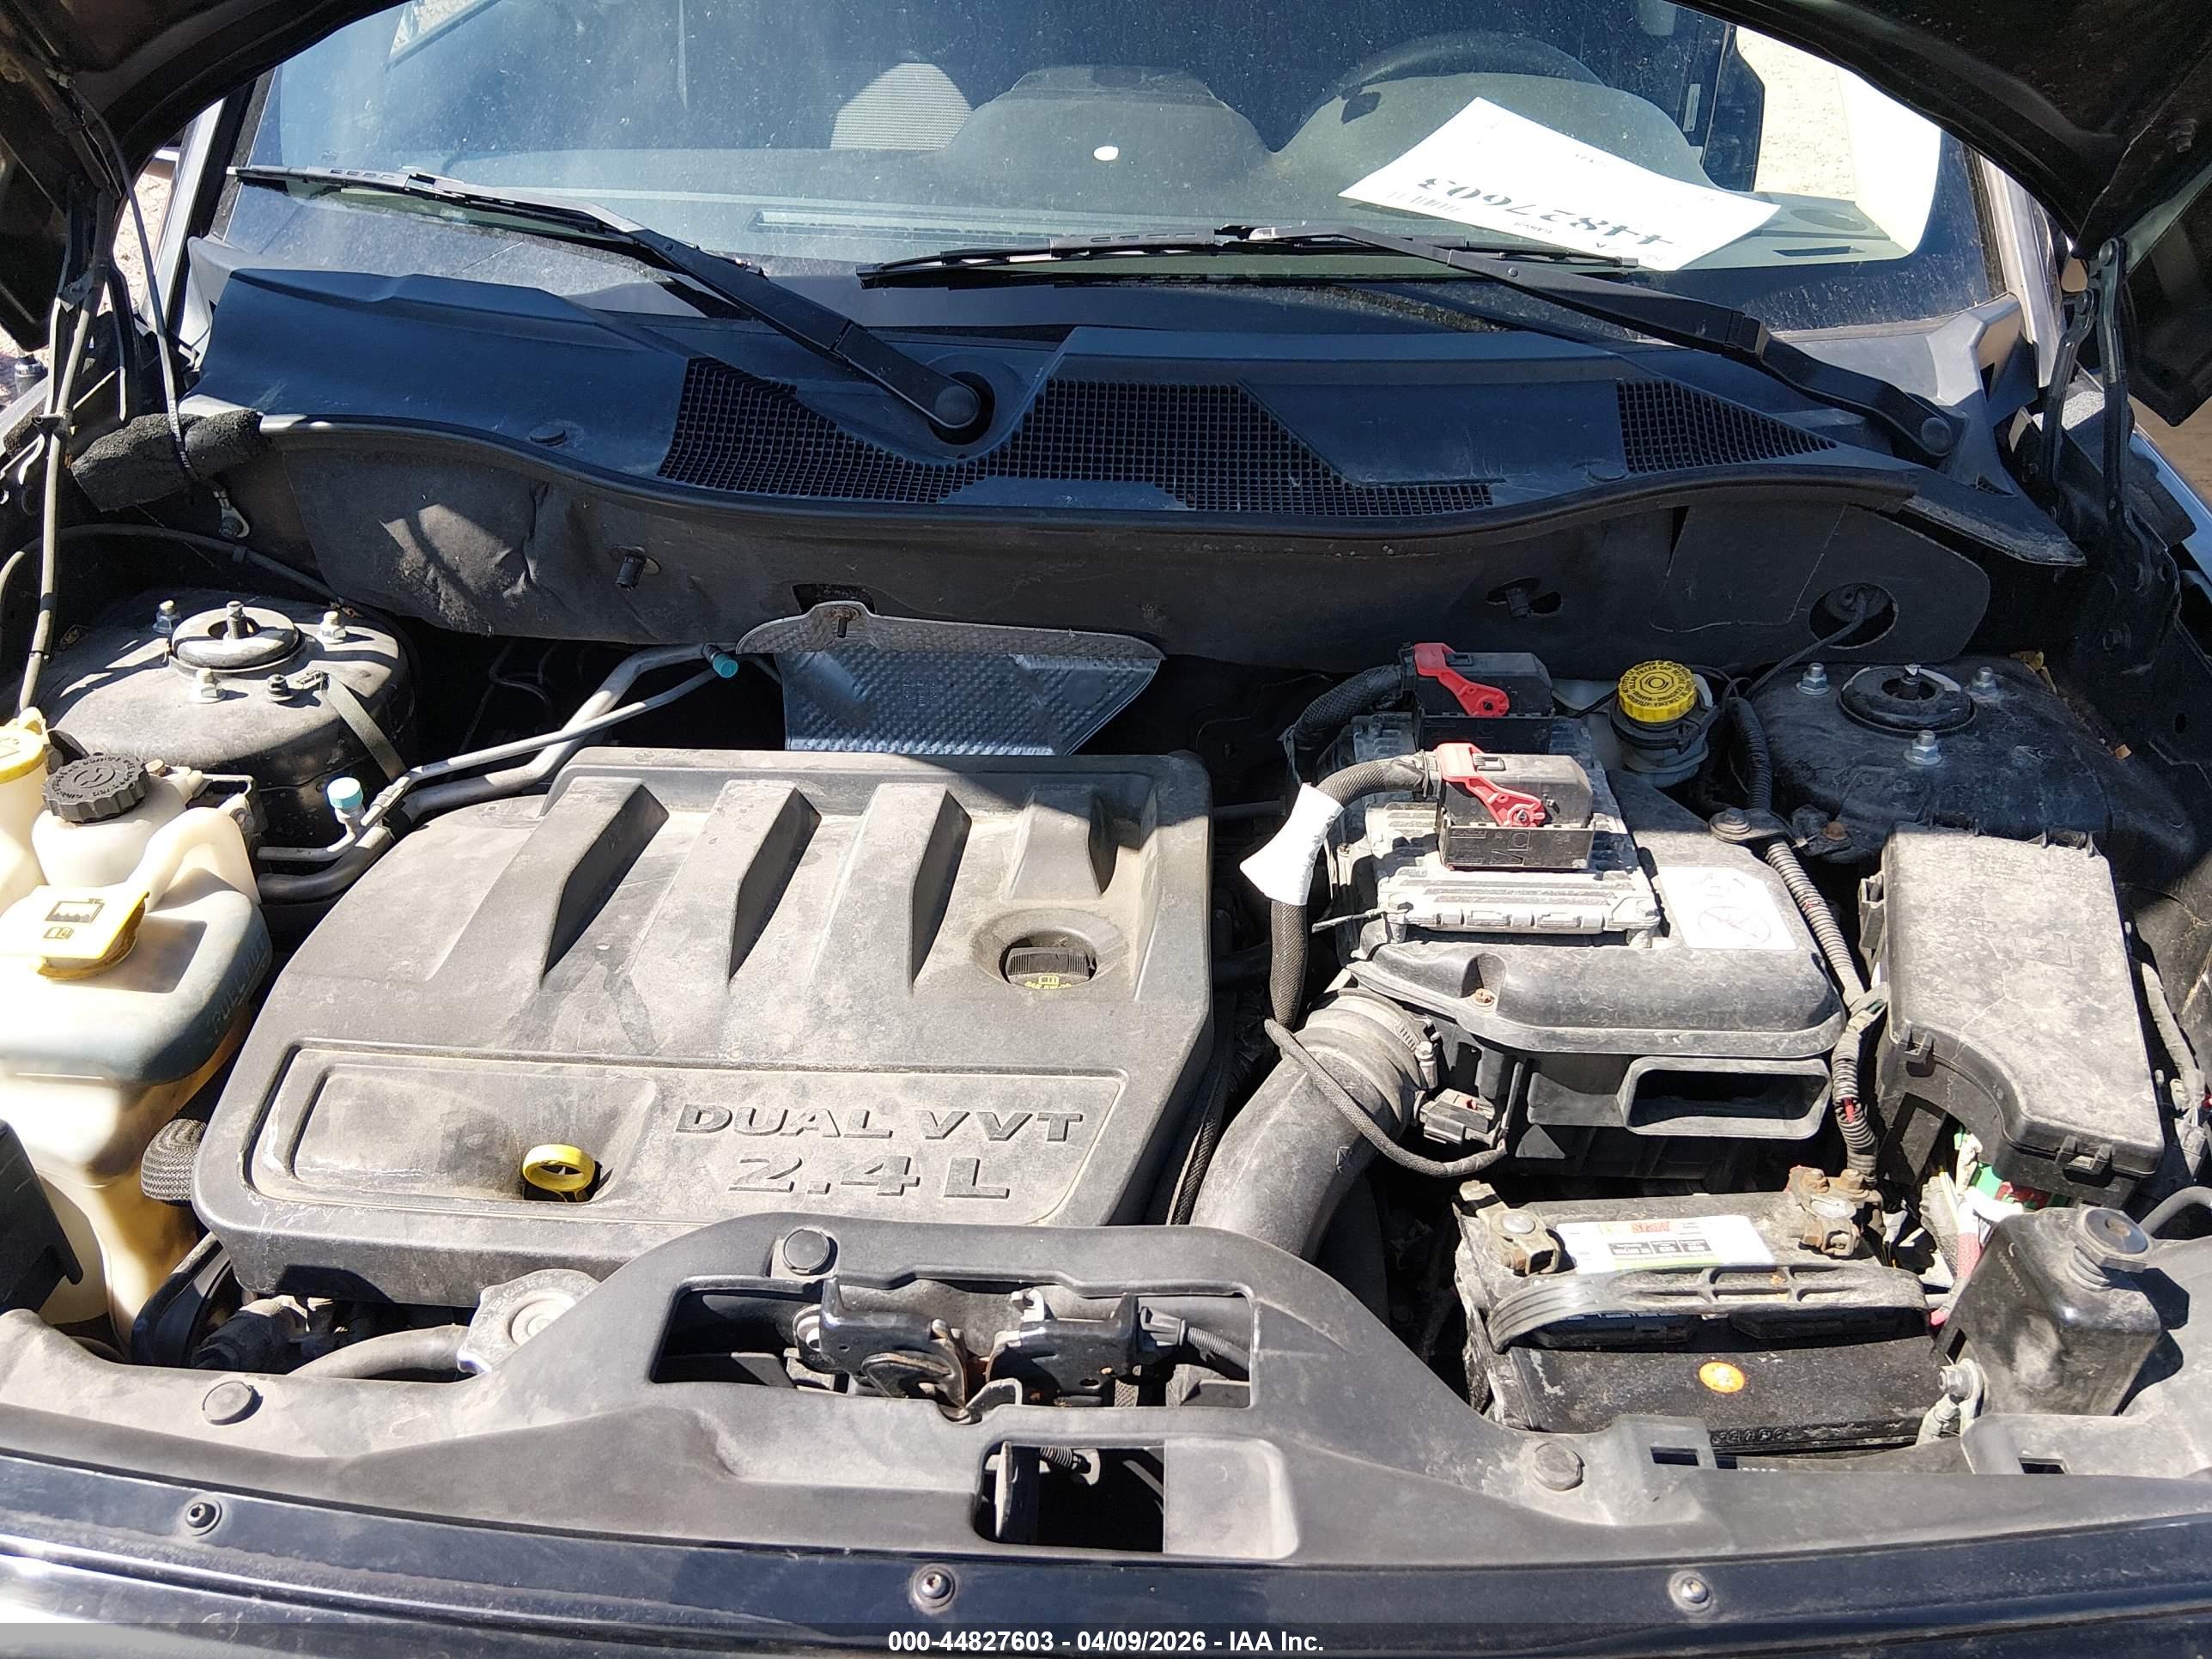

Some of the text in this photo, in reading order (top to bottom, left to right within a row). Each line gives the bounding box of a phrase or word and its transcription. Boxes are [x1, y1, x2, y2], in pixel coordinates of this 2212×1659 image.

[1419, 179, 1673, 244] 44827603
[676, 1103, 1084, 1142] DUAL VVT
